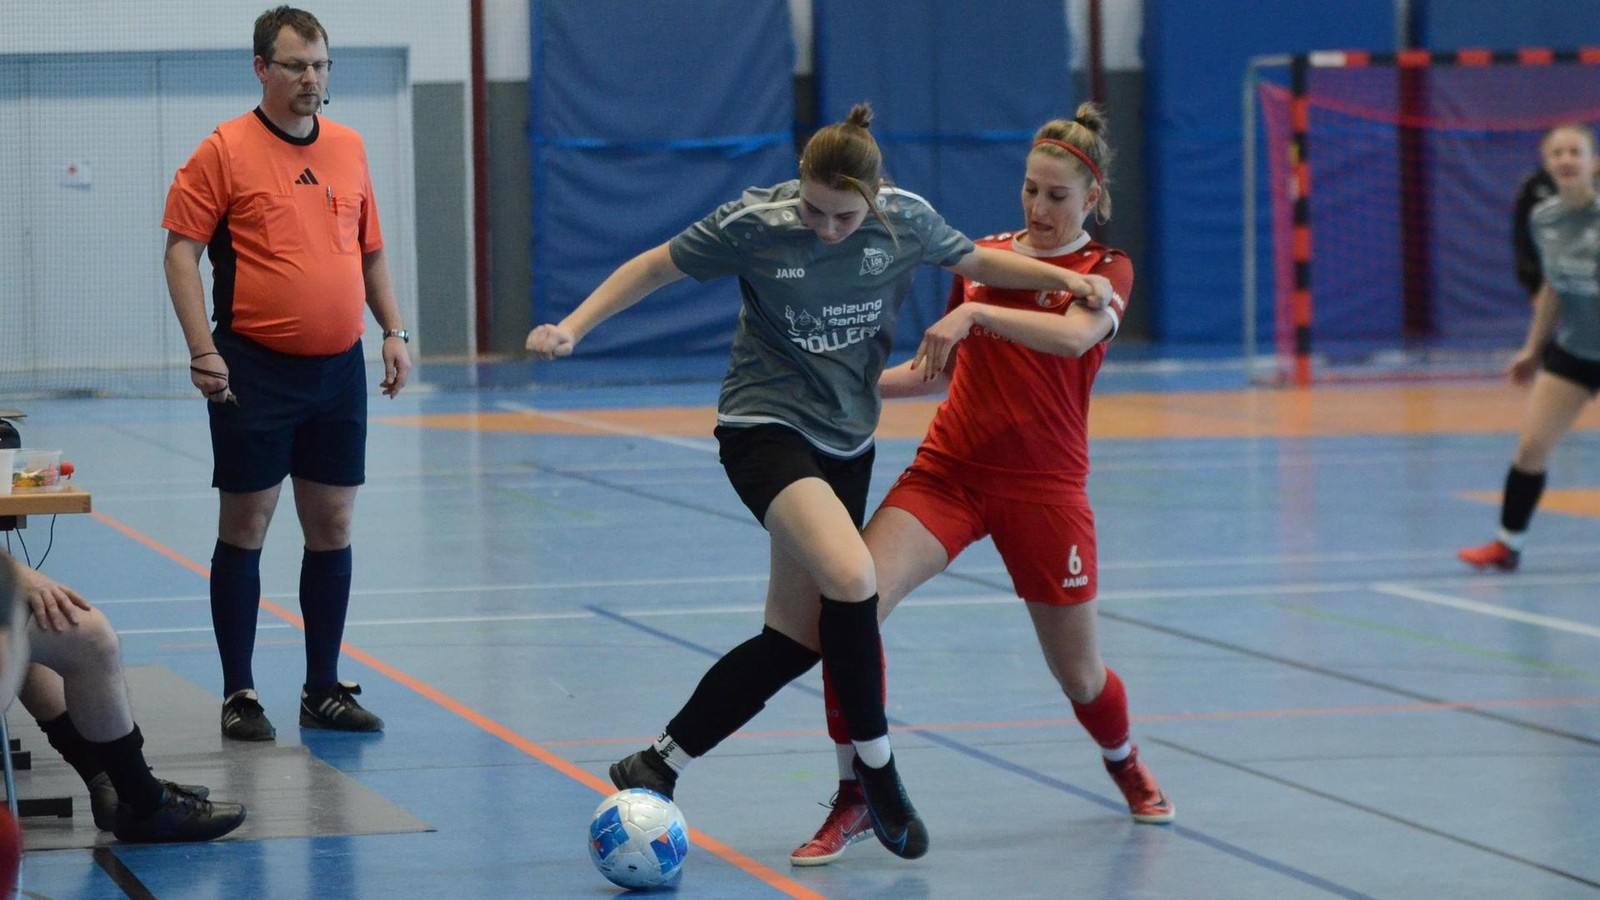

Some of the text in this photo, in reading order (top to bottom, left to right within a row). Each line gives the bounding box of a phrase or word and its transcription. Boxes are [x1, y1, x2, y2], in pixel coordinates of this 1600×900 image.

[775, 267, 805, 279] JAKO
[822, 299, 882, 317] Heizung
[1068, 544, 1082, 575] 6
[1062, 575, 1089, 588] JAKO
